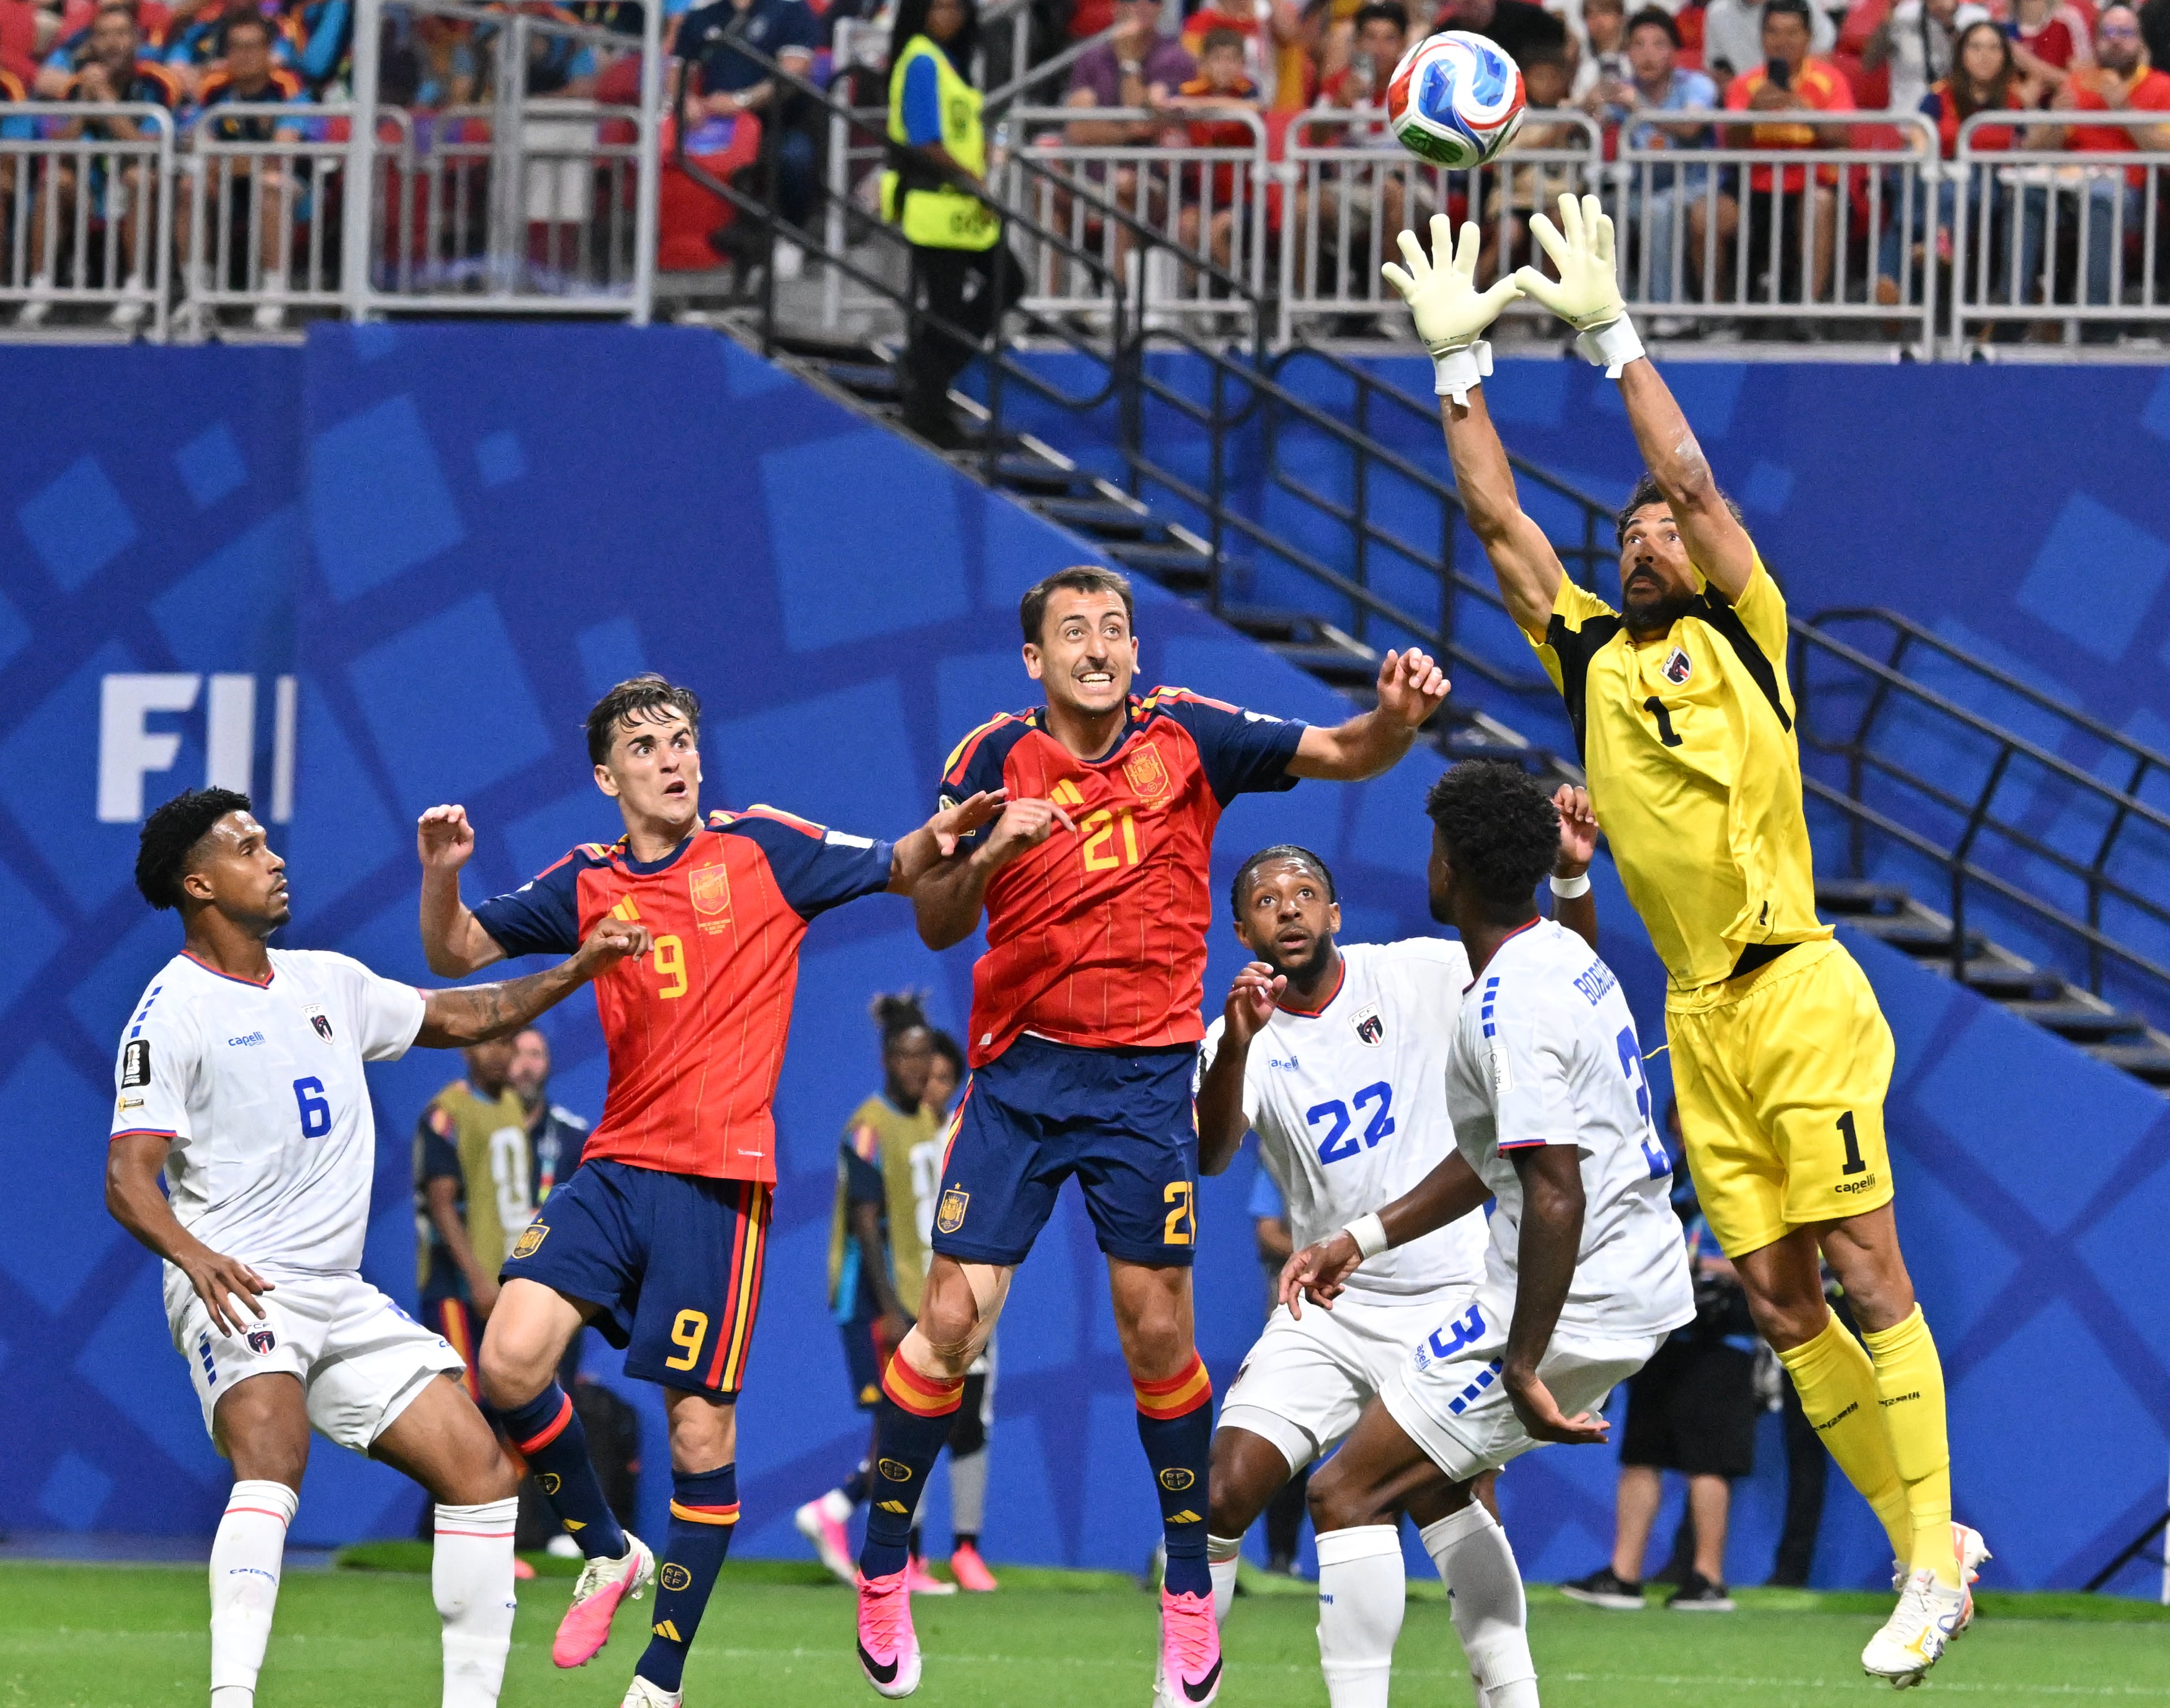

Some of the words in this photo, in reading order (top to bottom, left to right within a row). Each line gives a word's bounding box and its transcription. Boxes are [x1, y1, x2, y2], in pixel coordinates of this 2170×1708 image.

[1643, 696, 1683, 747] 1
[1081, 808, 1139, 872] 21
[654, 935, 688, 999] 9
[228, 1031, 264, 1046] capelli
[293, 1076, 331, 1139] 6
[1306, 1081, 1395, 1165] 22
[1836, 1111, 1867, 1176] 1
[1164, 1181, 1196, 1245] 21
[1835, 1173, 1876, 1194] capelli
[665, 1308, 709, 1371] 9
[1429, 1304, 1486, 1358] 3
